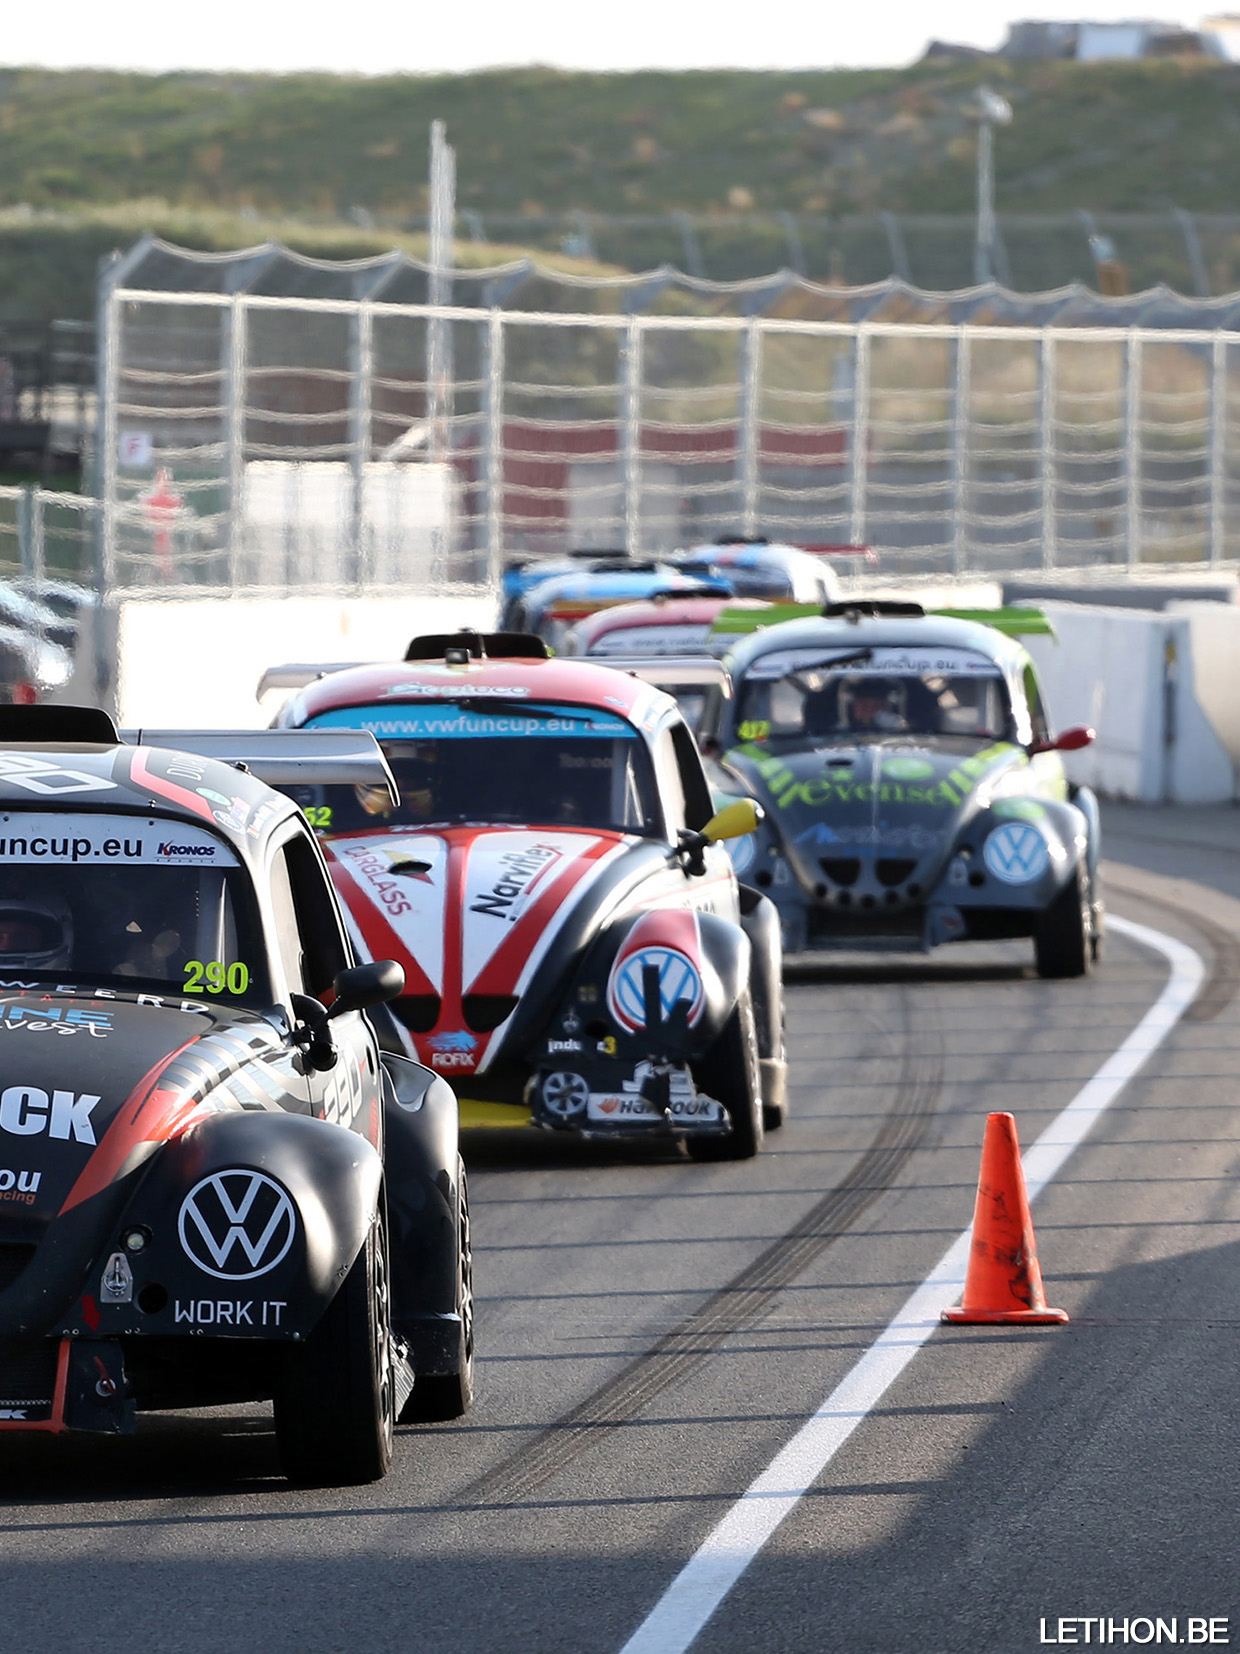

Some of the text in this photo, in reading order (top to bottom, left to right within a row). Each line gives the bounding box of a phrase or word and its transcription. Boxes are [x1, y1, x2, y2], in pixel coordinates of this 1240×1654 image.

[361, 715, 574, 734] www.vwfuncup.eu
[158, 840, 215, 856] KRONOS
[183, 961, 249, 995] 290
[175, 1300, 287, 1326] WORK IT
